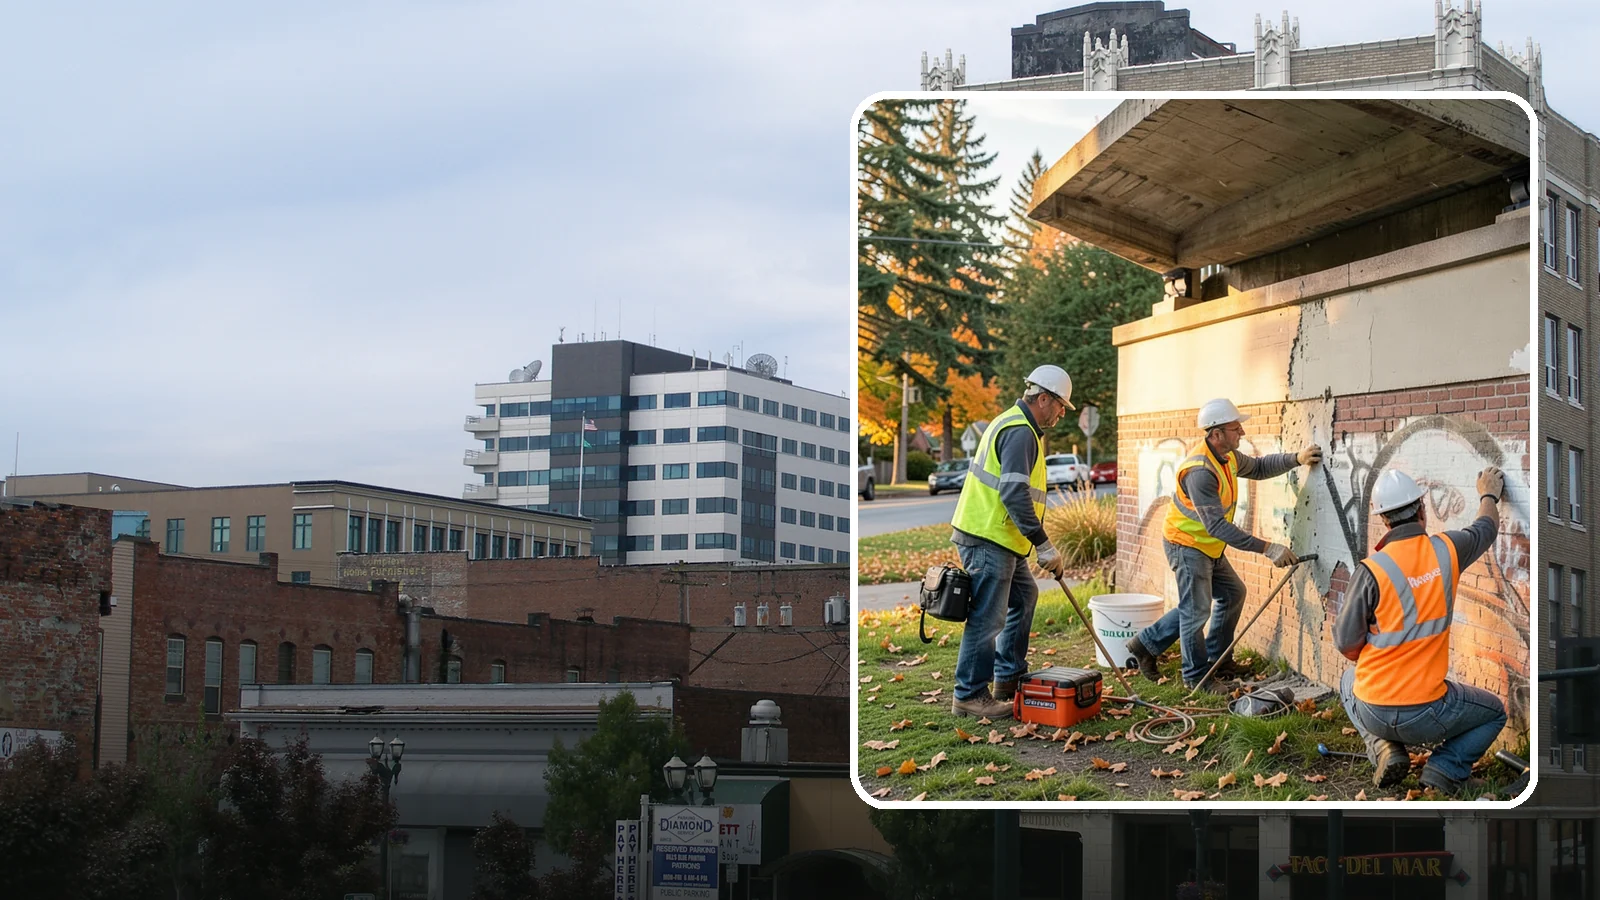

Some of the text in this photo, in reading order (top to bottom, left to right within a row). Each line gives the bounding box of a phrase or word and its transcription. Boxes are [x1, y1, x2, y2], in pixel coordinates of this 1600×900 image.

[370, 566, 427, 577] Furnishers
[660, 818, 713, 833] DIAMOND
[1021, 815, 1070, 828] BUILDING
[719, 824, 740, 835] ETT
[719, 839, 740, 848] ANT
[656, 845, 716, 854] RESERVED PARKING
[722, 851, 739, 862] Soup
[671, 861, 701, 870] PATRONS
[1289, 855, 1442, 877] TAC DEL MAR
[660, 888, 710, 898] PUBLIC PARKING
